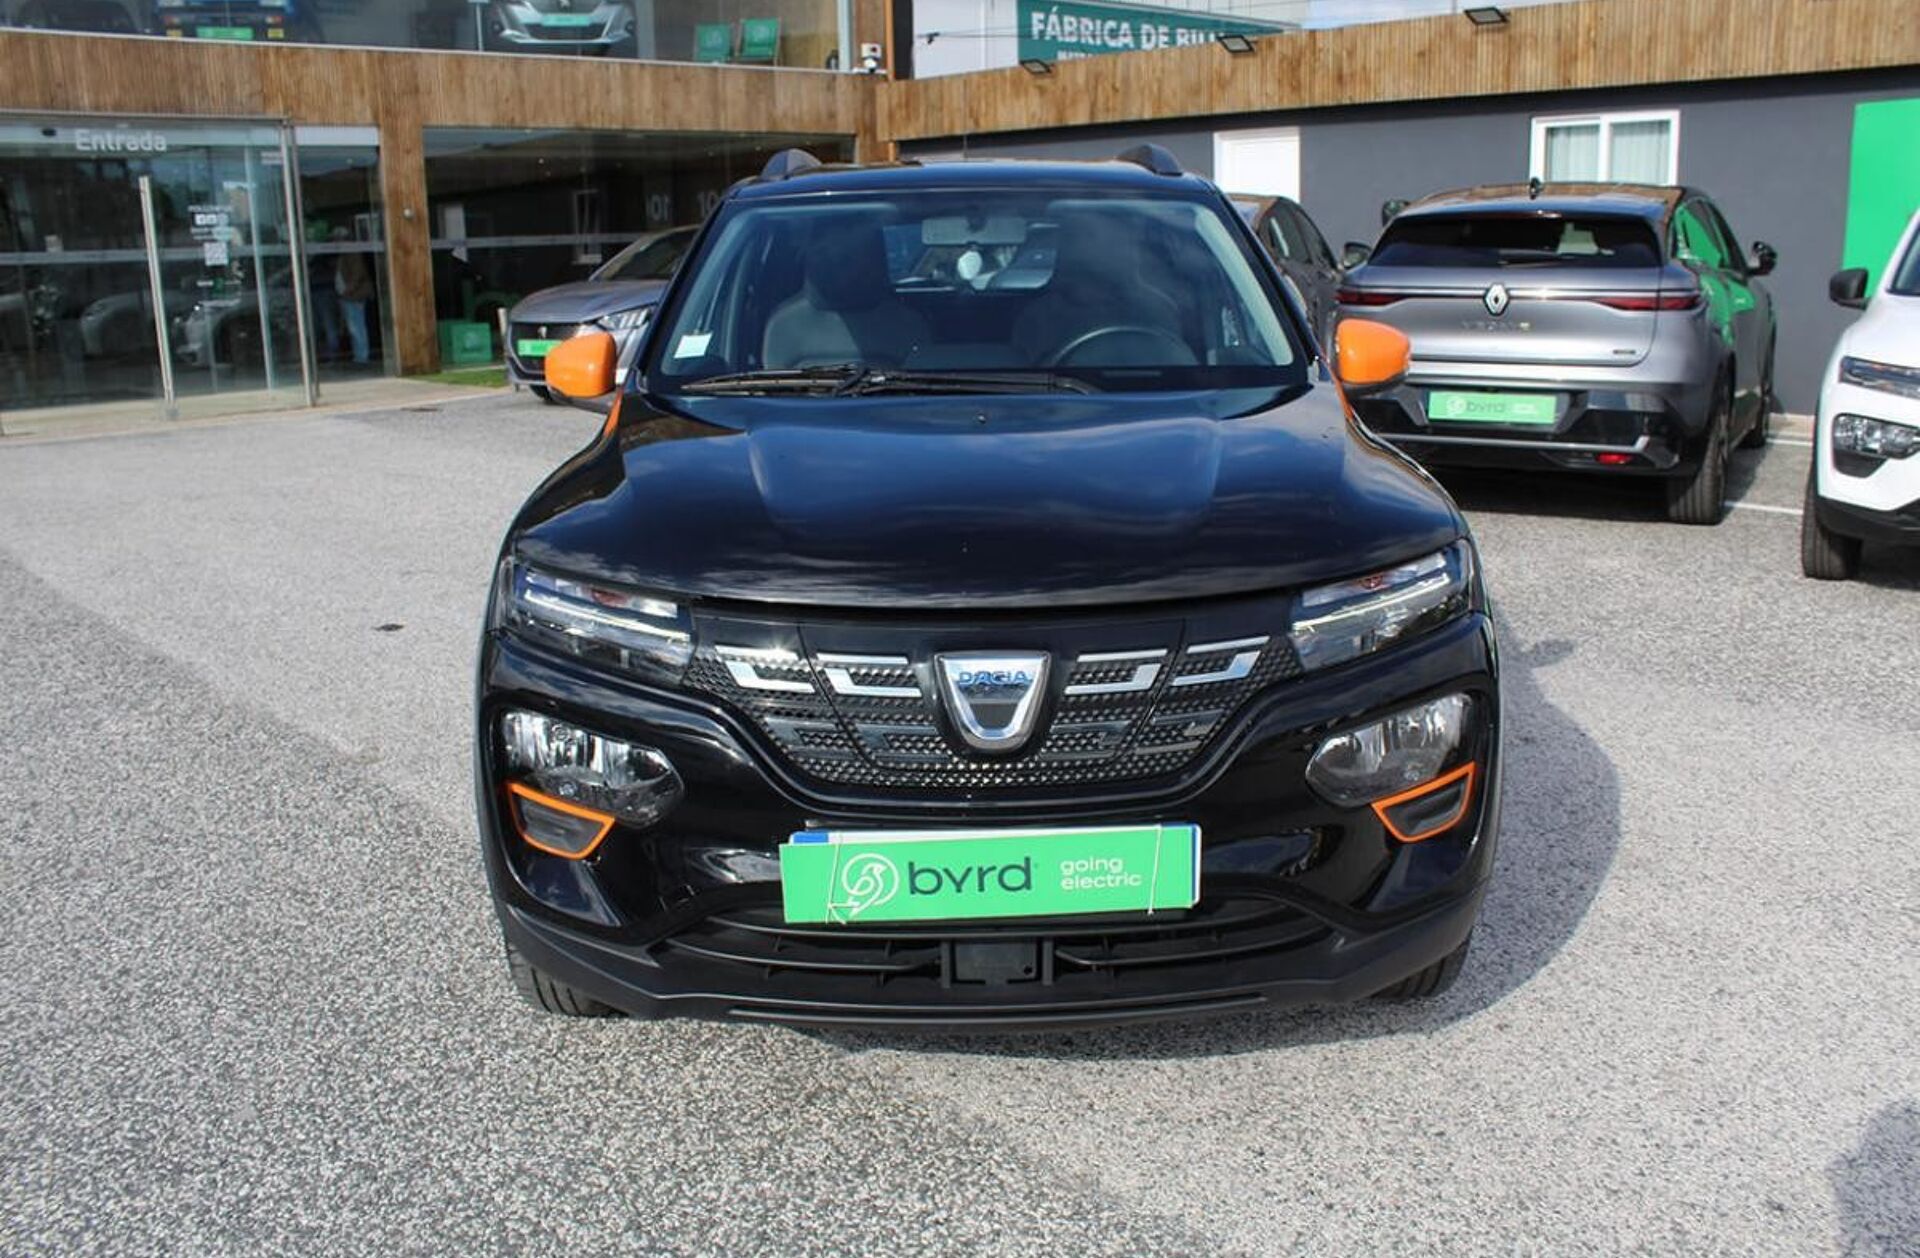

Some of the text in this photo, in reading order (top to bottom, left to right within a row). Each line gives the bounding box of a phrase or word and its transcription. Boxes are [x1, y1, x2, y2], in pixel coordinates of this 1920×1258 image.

[1031, 6, 1134, 49] FÁBRICA
[1140, 24, 1169, 50] DE
[74, 129, 167, 151] Entrada
[959, 670, 1031, 686] DACIA
[908, 856, 1031, 895] byrd
[1060, 856, 1123, 875] going
[1060, 872, 1142, 890] electric
